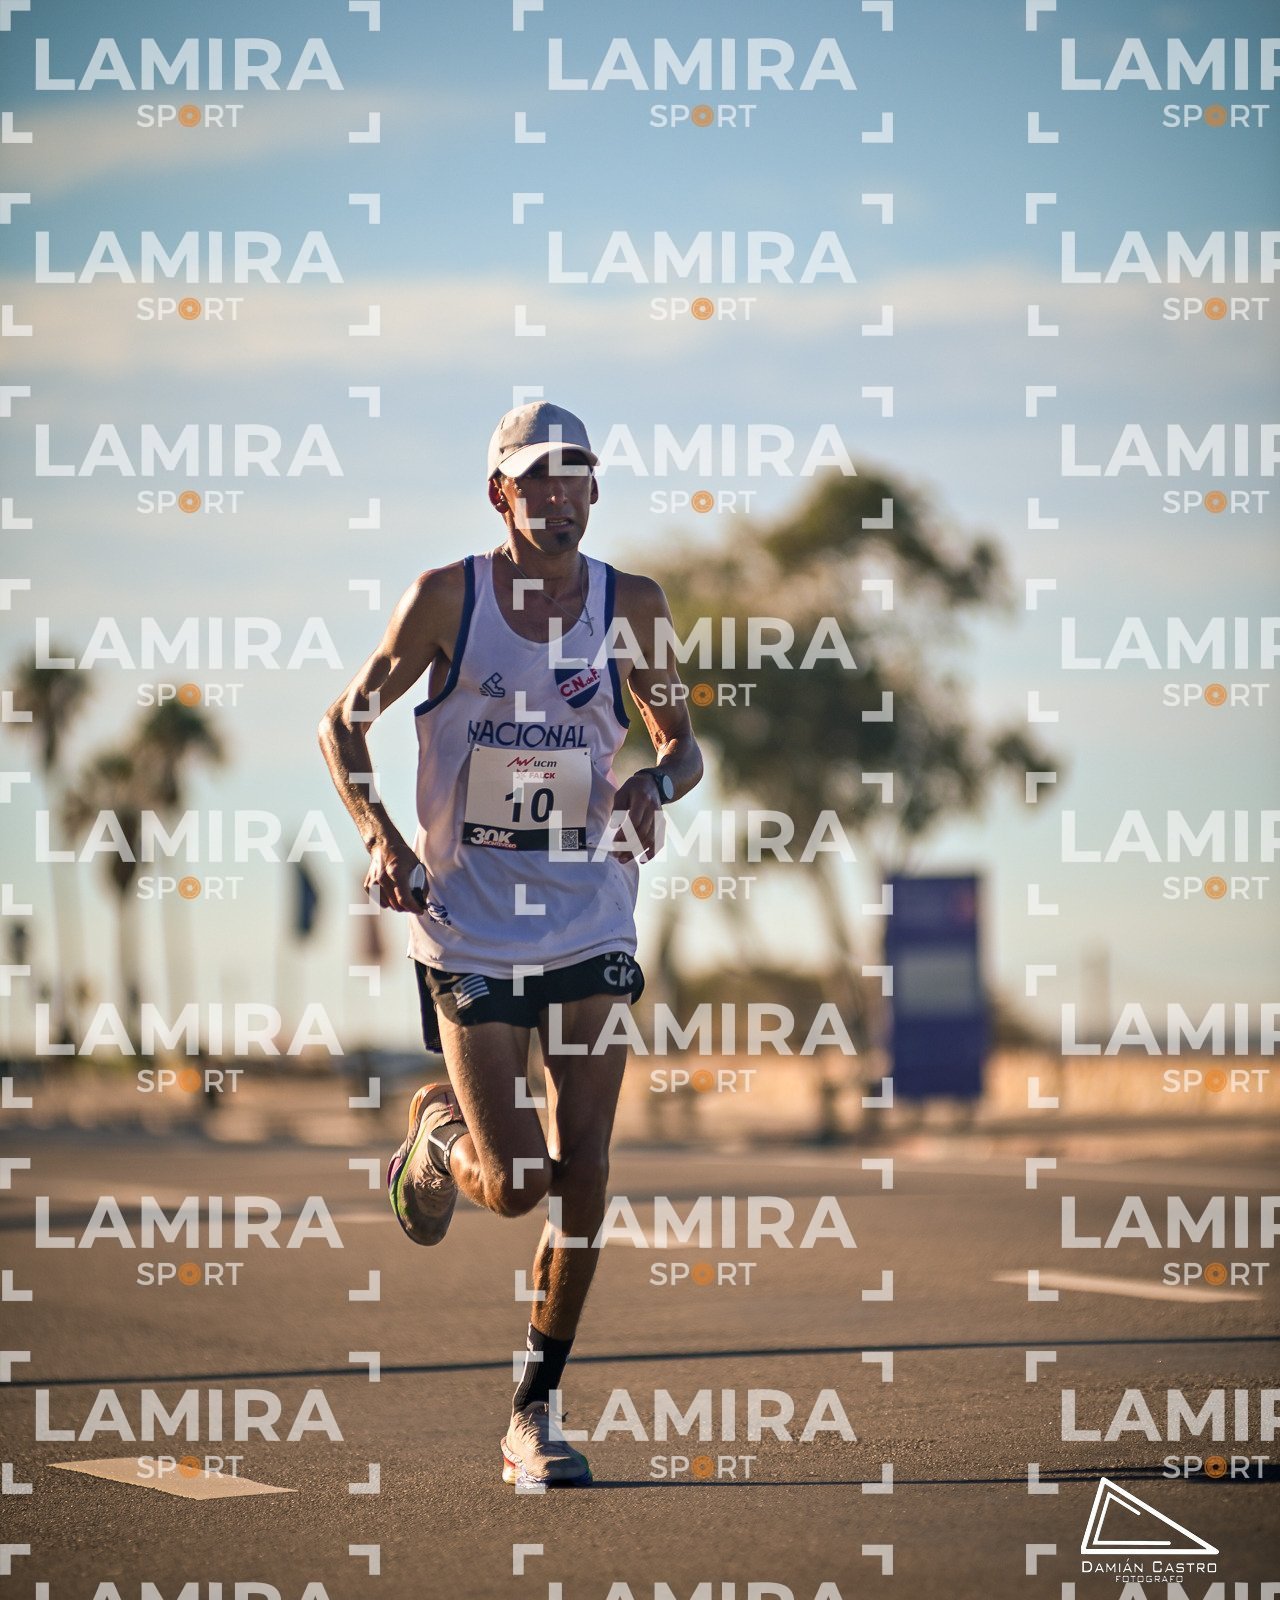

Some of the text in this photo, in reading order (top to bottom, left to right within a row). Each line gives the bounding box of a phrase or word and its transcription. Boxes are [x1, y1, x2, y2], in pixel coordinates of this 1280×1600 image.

[467, 720, 587, 748] NACIONAL
[533, 760, 557, 768] ucm
[505, 787, 555, 823] 10
[470, 827, 514, 845] 30K
[603, 965, 635, 987] CK
